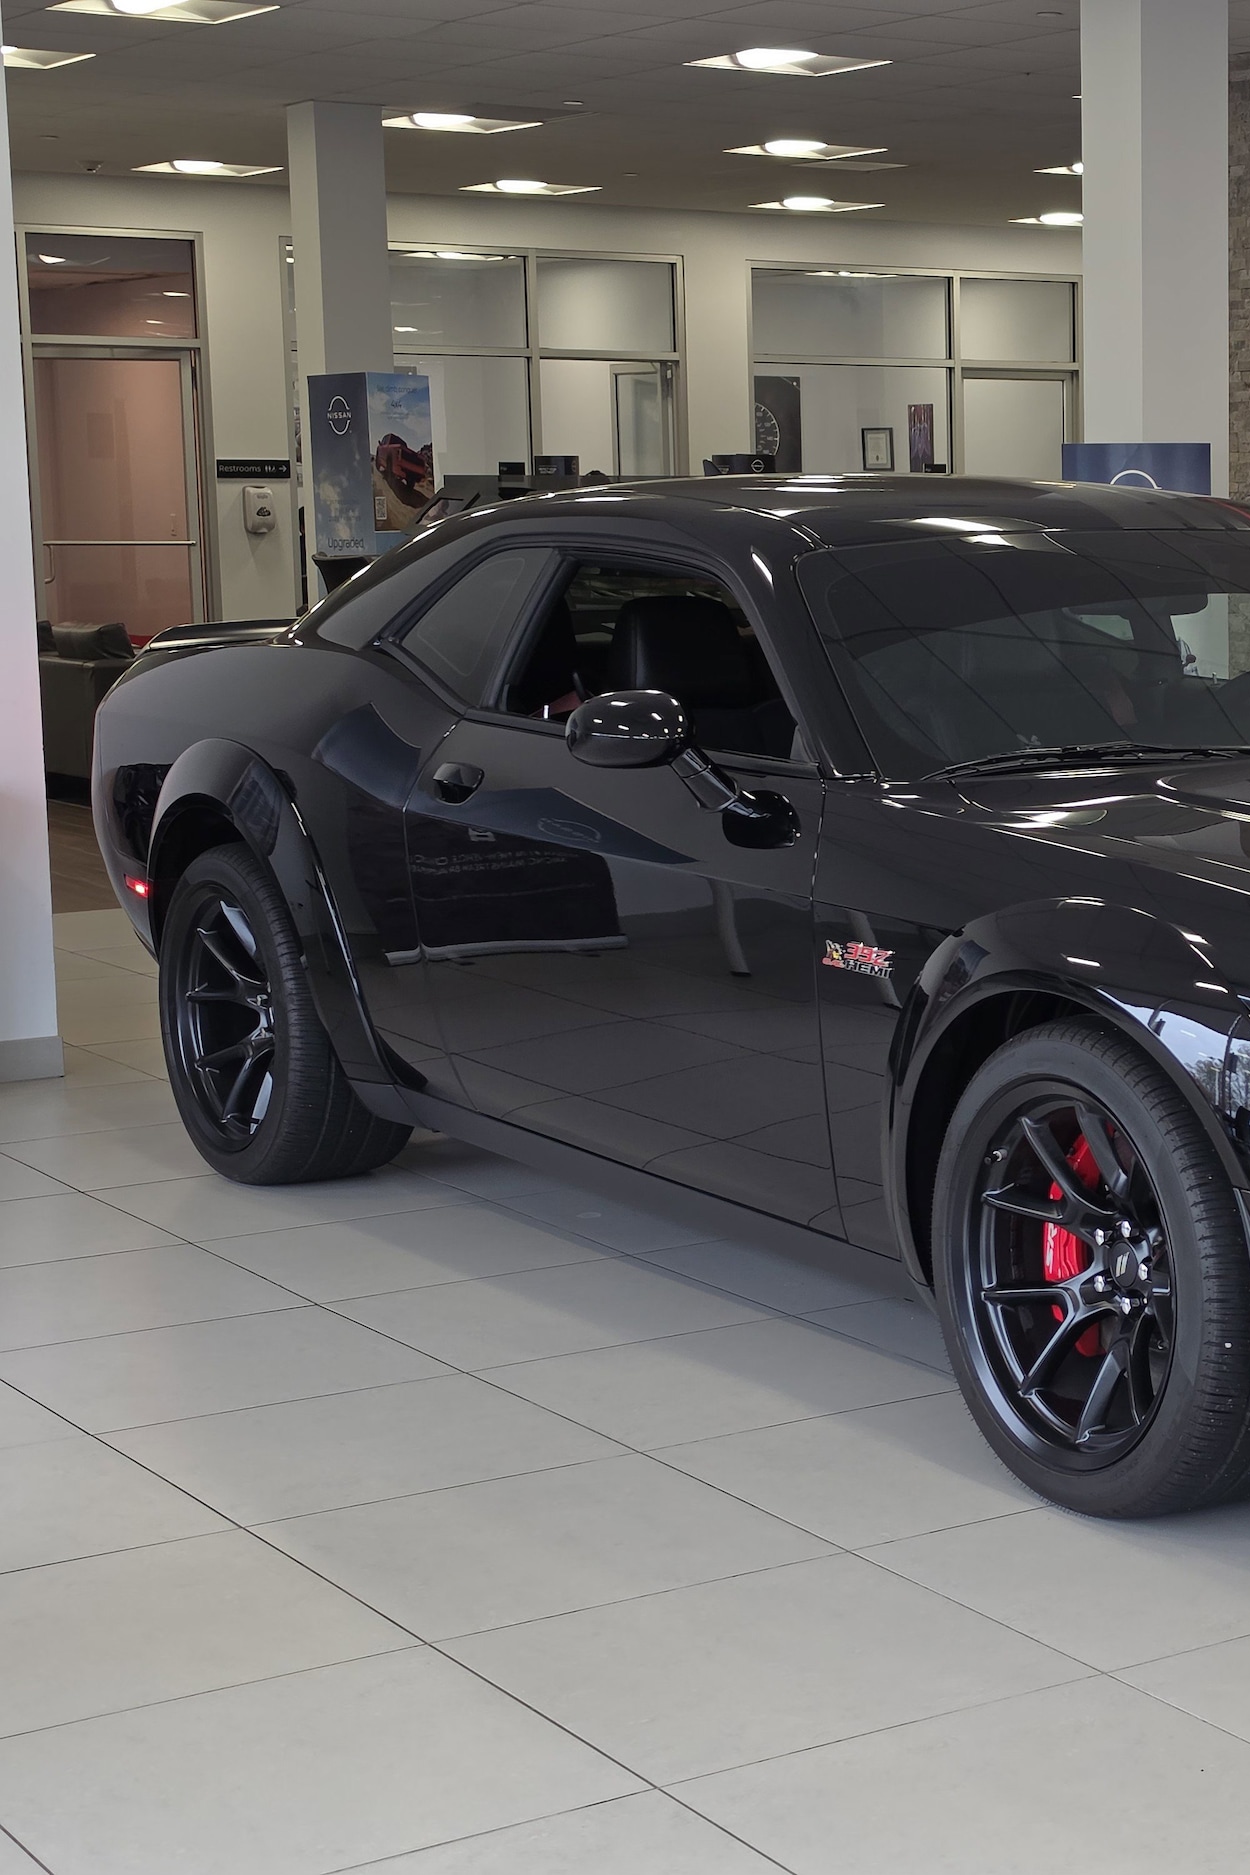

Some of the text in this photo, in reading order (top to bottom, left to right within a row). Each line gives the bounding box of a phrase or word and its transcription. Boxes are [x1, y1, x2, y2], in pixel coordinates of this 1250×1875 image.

[327, 411, 352, 419] NISSAN
[219, 465, 261, 473] Restrooms
[844, 942, 894, 967] 392
[845, 960, 894, 978] HEMI
[1045, 1222, 1058, 1274] SR
